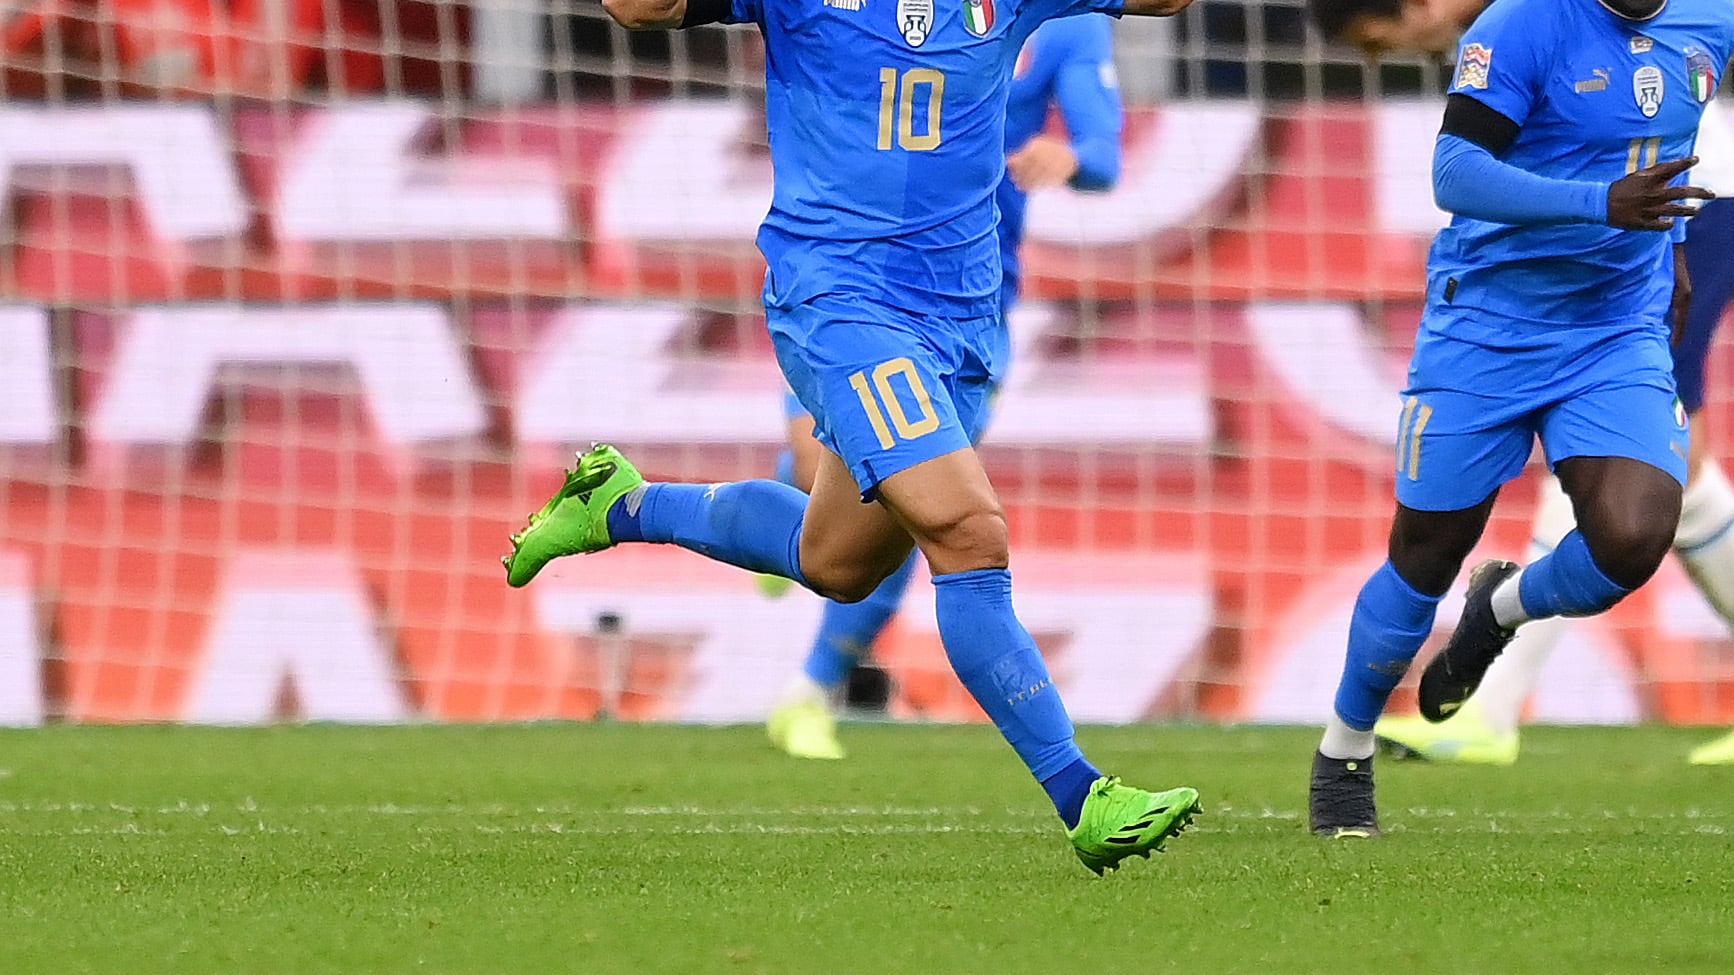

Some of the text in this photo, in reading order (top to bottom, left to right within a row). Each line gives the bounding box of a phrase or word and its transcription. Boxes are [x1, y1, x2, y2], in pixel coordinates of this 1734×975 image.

[877, 68, 945, 151] 10
[849, 357, 941, 450] 10
[1397, 396, 1433, 481] 11
